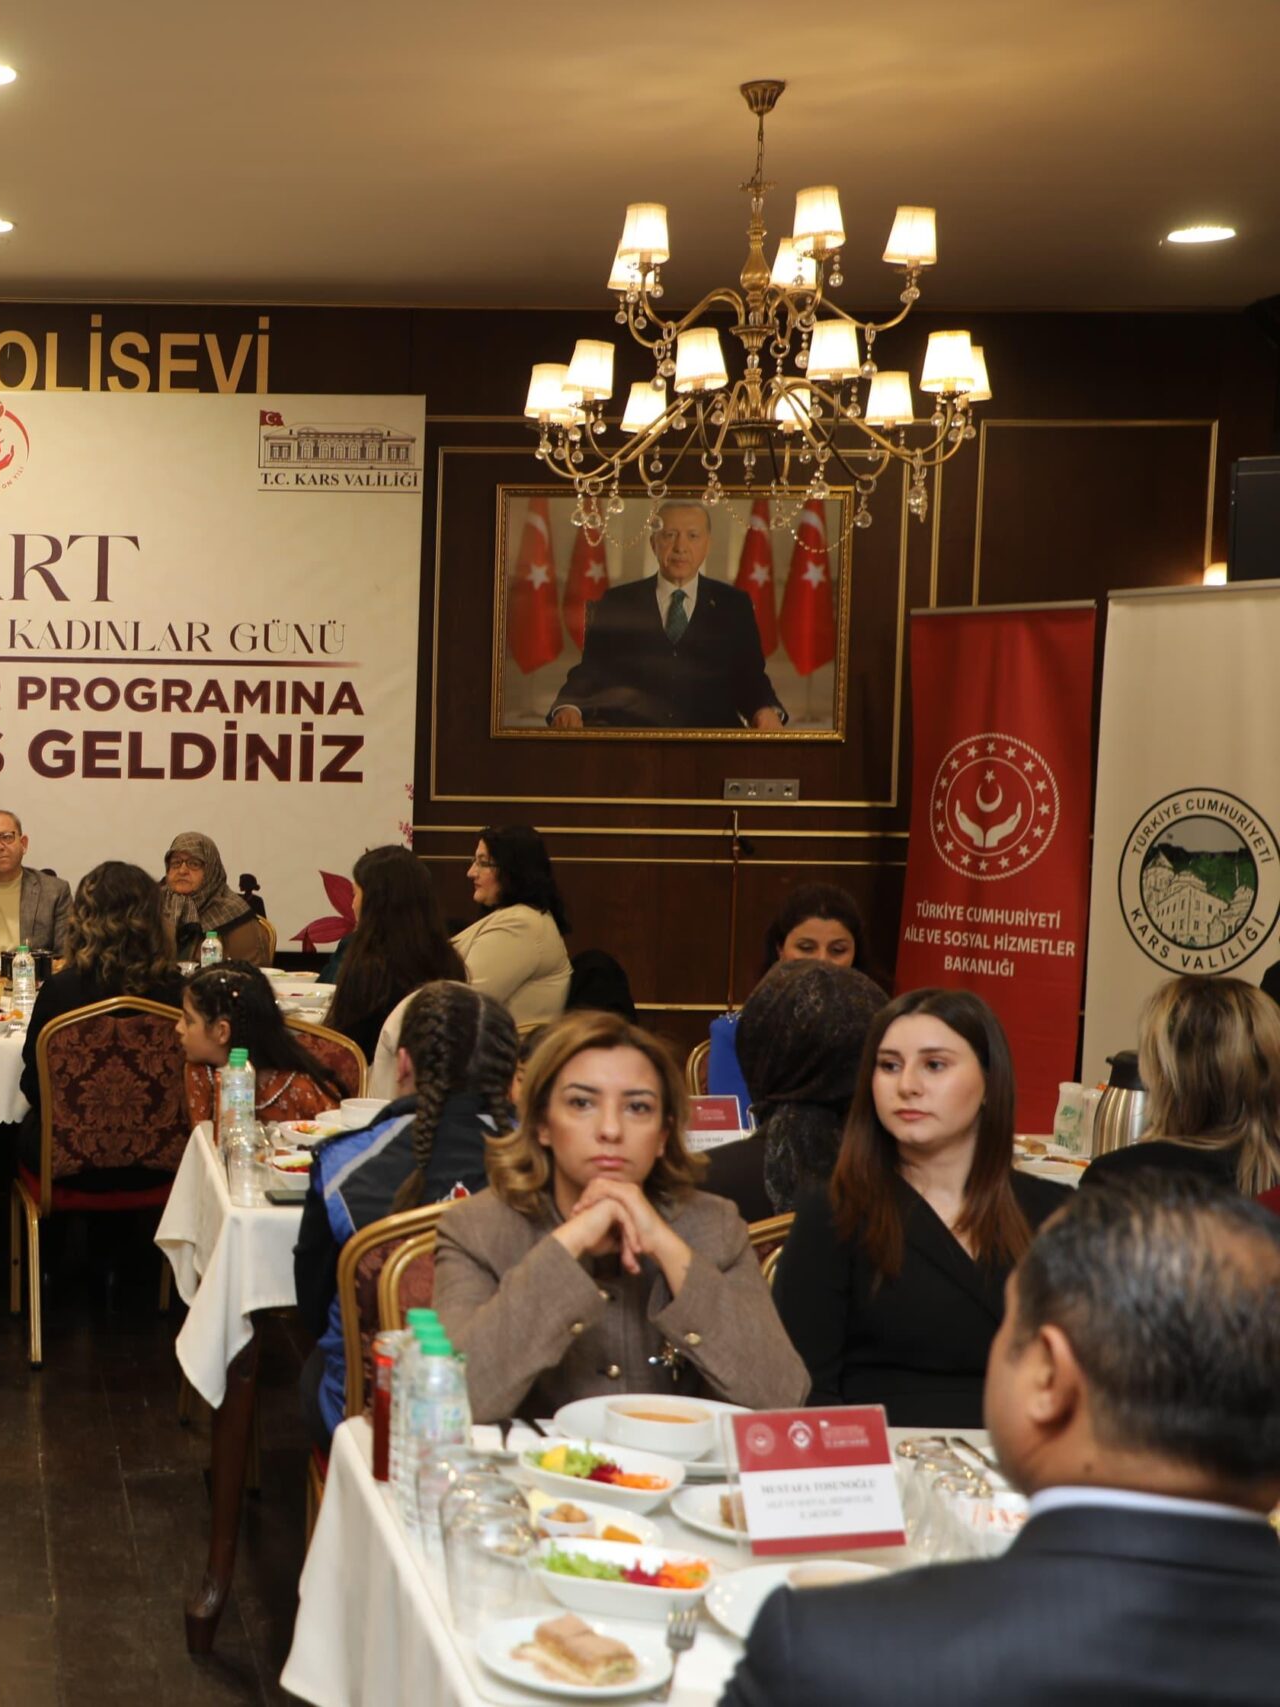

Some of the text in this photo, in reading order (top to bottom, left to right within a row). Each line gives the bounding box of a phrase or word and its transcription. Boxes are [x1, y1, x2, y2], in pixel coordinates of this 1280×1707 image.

[261, 471, 418, 487] T.C. KARS VALİLİĞİ
[9, 618, 213, 652] KADINLAR
[229, 619, 346, 654] GÜNÜ
[17, 676, 365, 716] PROGRAMINA
[28, 720, 365, 783] GELDİNİZ
[1131, 798, 1275, 864] TÜRKİYE CUMHURİYETİ
[916, 900, 1061, 929] TÜRKİYE CUMHURİYETİ
[904, 923, 1076, 957] AİLE VE SOSYAL HİZMETLER
[1131, 908, 1265, 970] KARS VALİLİĞİ
[944, 955, 1014, 977] BAKANLIĞI
